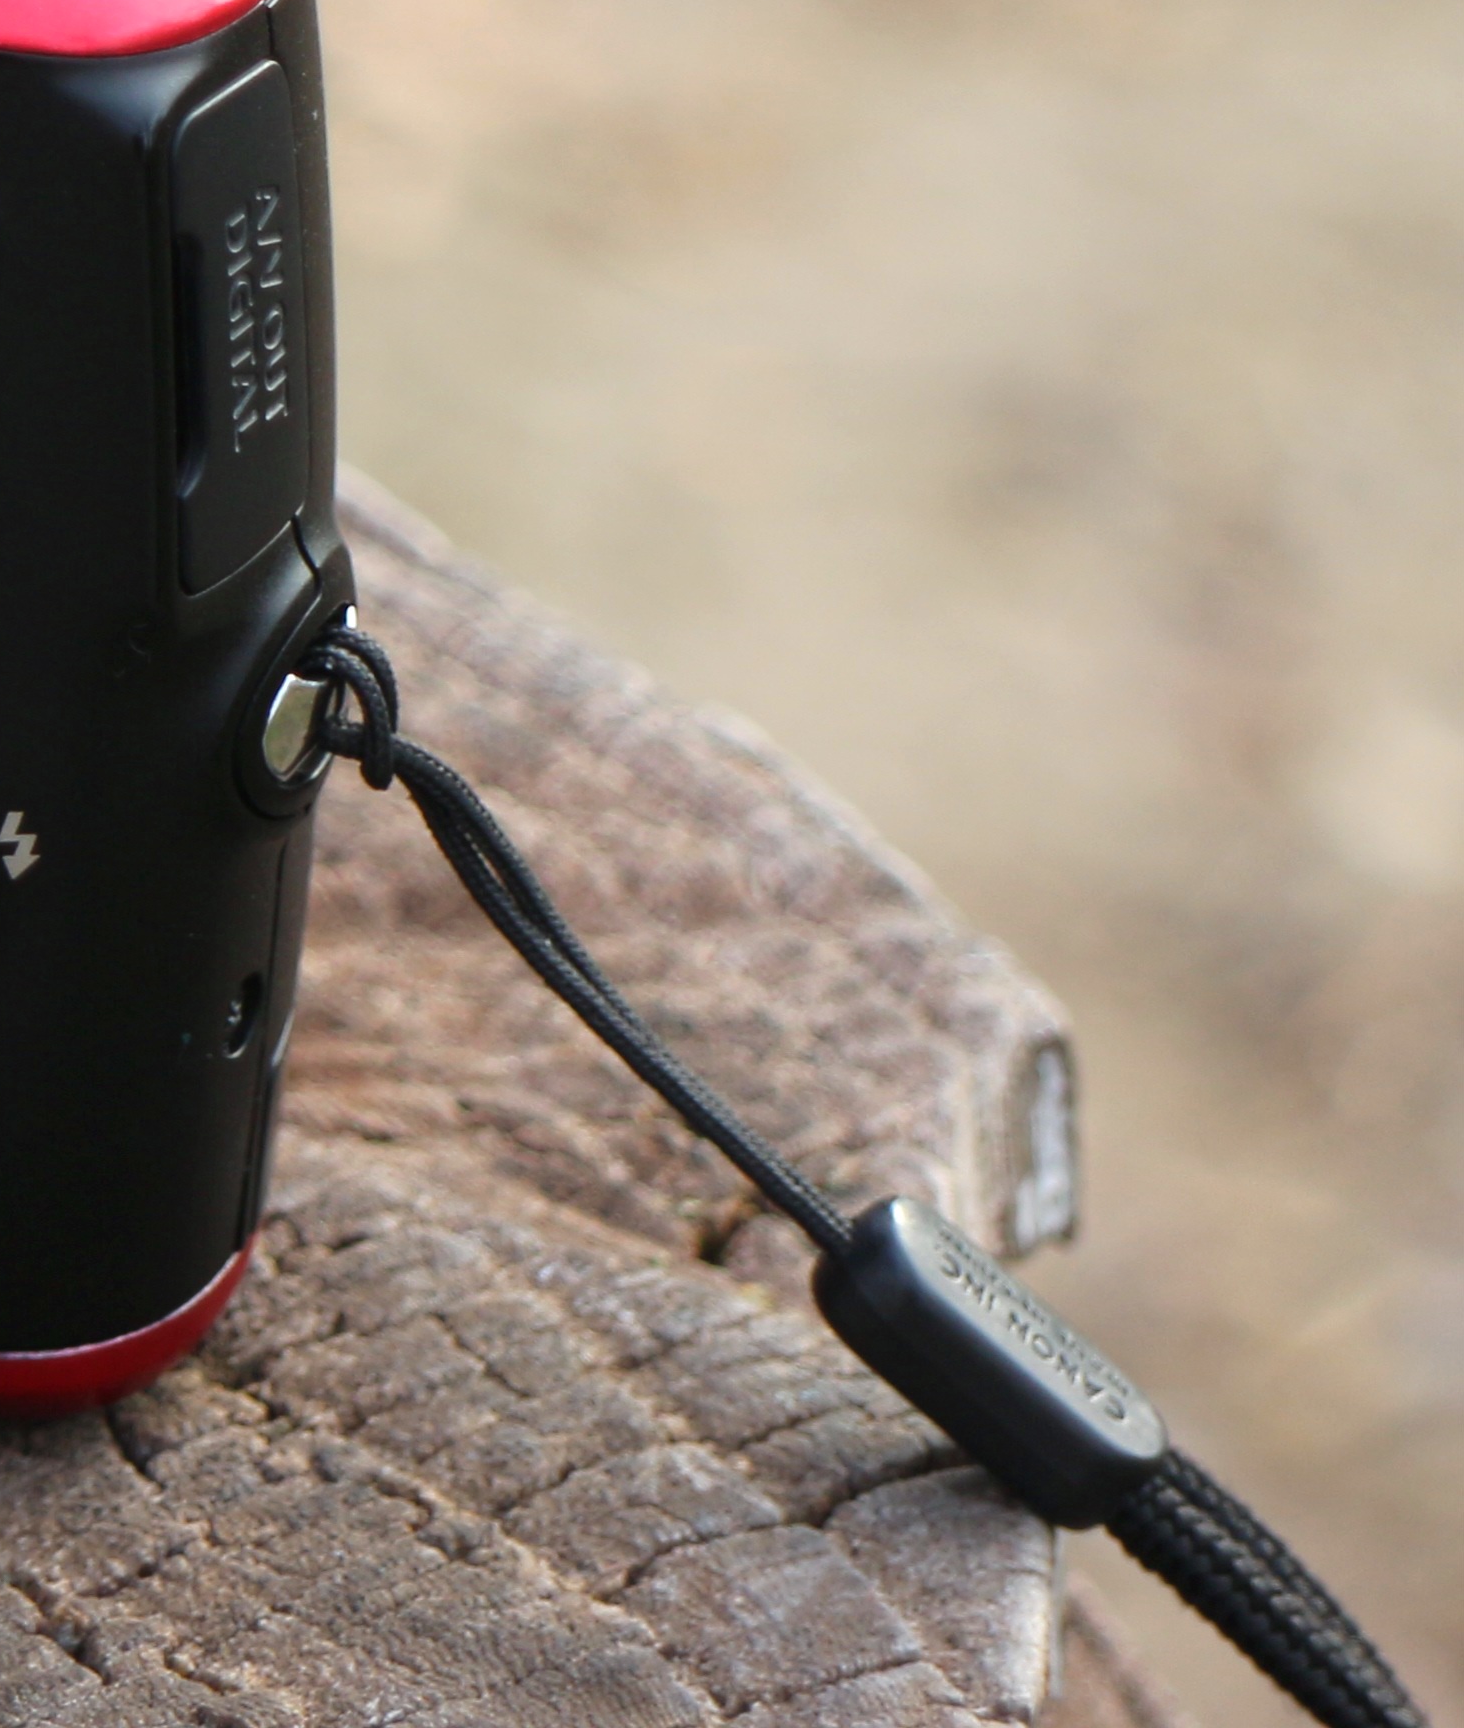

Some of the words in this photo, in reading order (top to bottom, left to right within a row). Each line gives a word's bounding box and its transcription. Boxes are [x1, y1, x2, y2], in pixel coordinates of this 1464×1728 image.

[225, 212, 259, 454] DIGITAL
[263, 303, 288, 420] OUT
[1007, 1312, 1129, 1421] CANON
